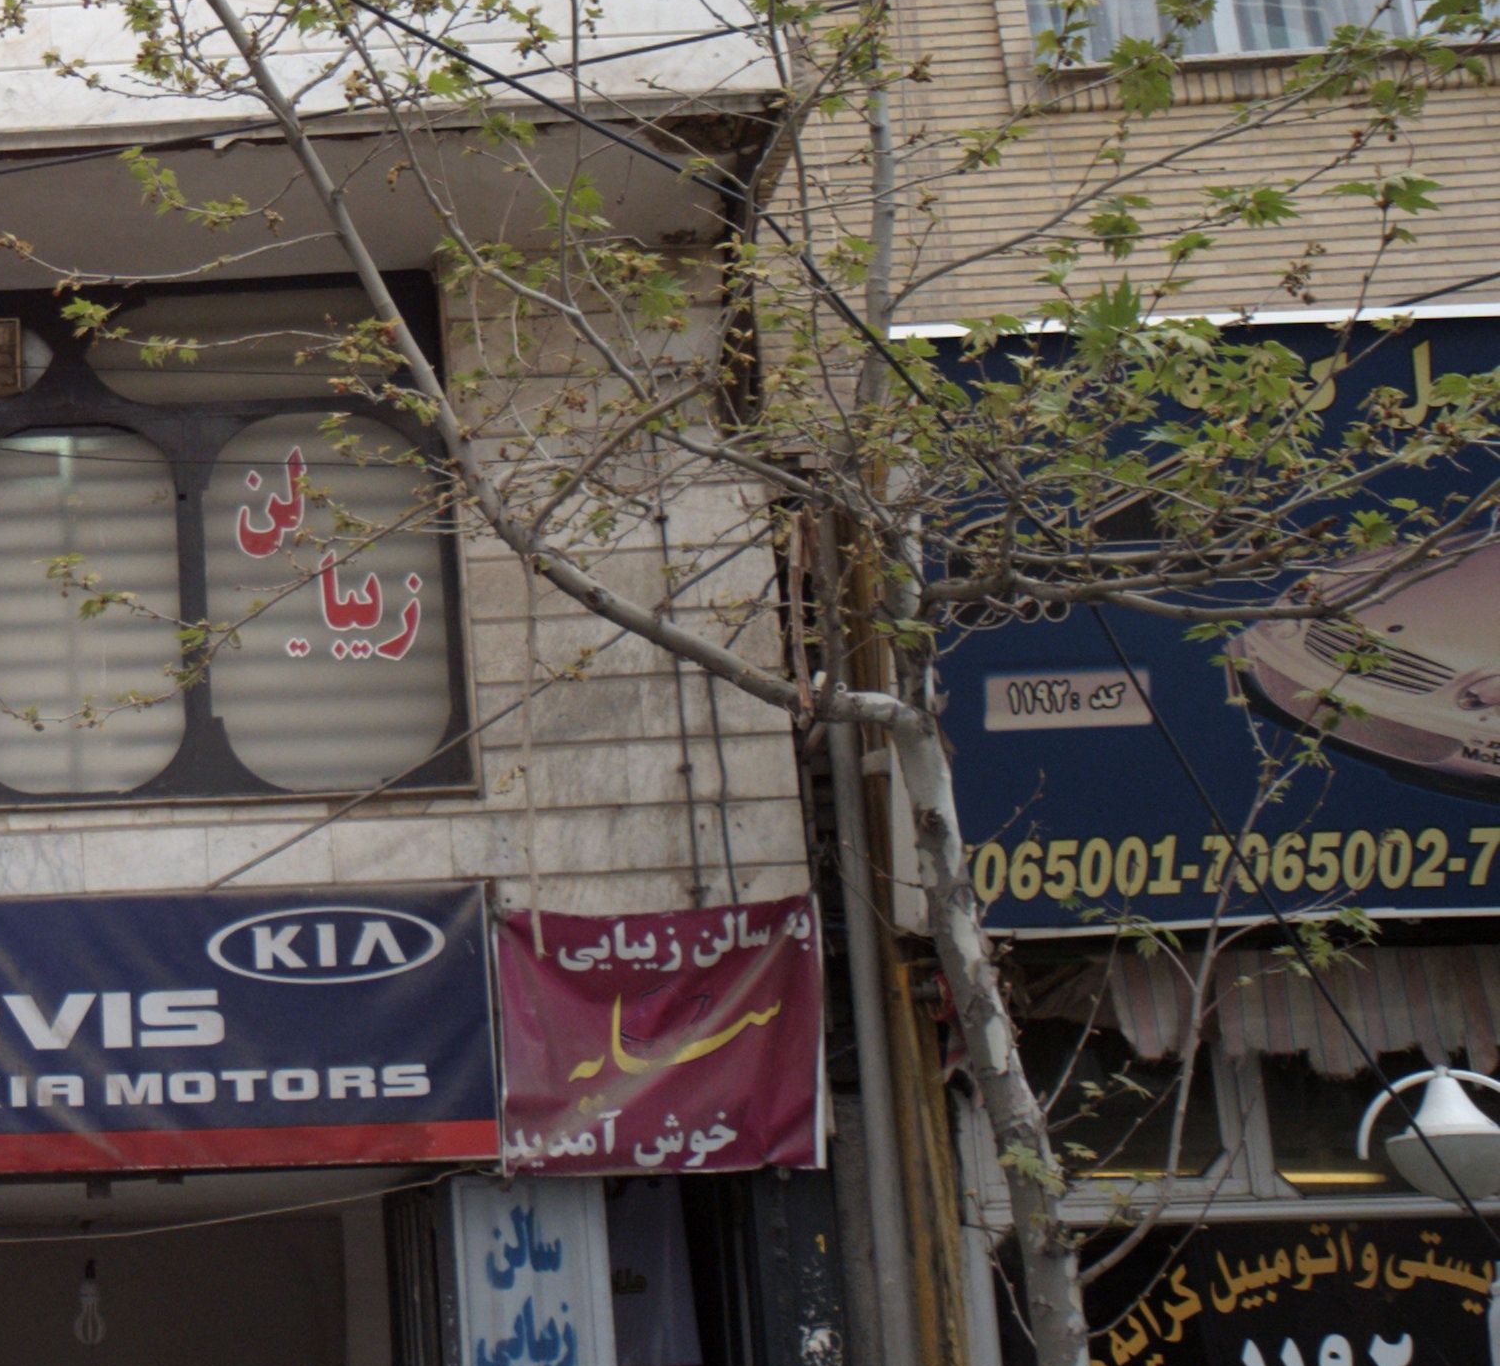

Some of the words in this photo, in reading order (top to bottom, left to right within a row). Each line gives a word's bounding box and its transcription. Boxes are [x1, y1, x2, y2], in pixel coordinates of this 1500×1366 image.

[1008, 679, 1070, 716] ۱۱۹۲
[252, 921, 408, 970] KIA
[557, 921, 683, 972] زیبایی
[692, 910, 772, 968] سالن
[785, 910, 812, 951] به
[568, 992, 783, 1114] سایه
[106, 1064, 432, 1106] MOTORS
[502, 1109, 622, 1168] آمدید
[633, 1110, 739, 1167] خوش
[486, 1204, 562, 1290] سالن
[1210, 1222, 1352, 1315] اتومبیل
[1354, 1241, 1380, 1290] و
